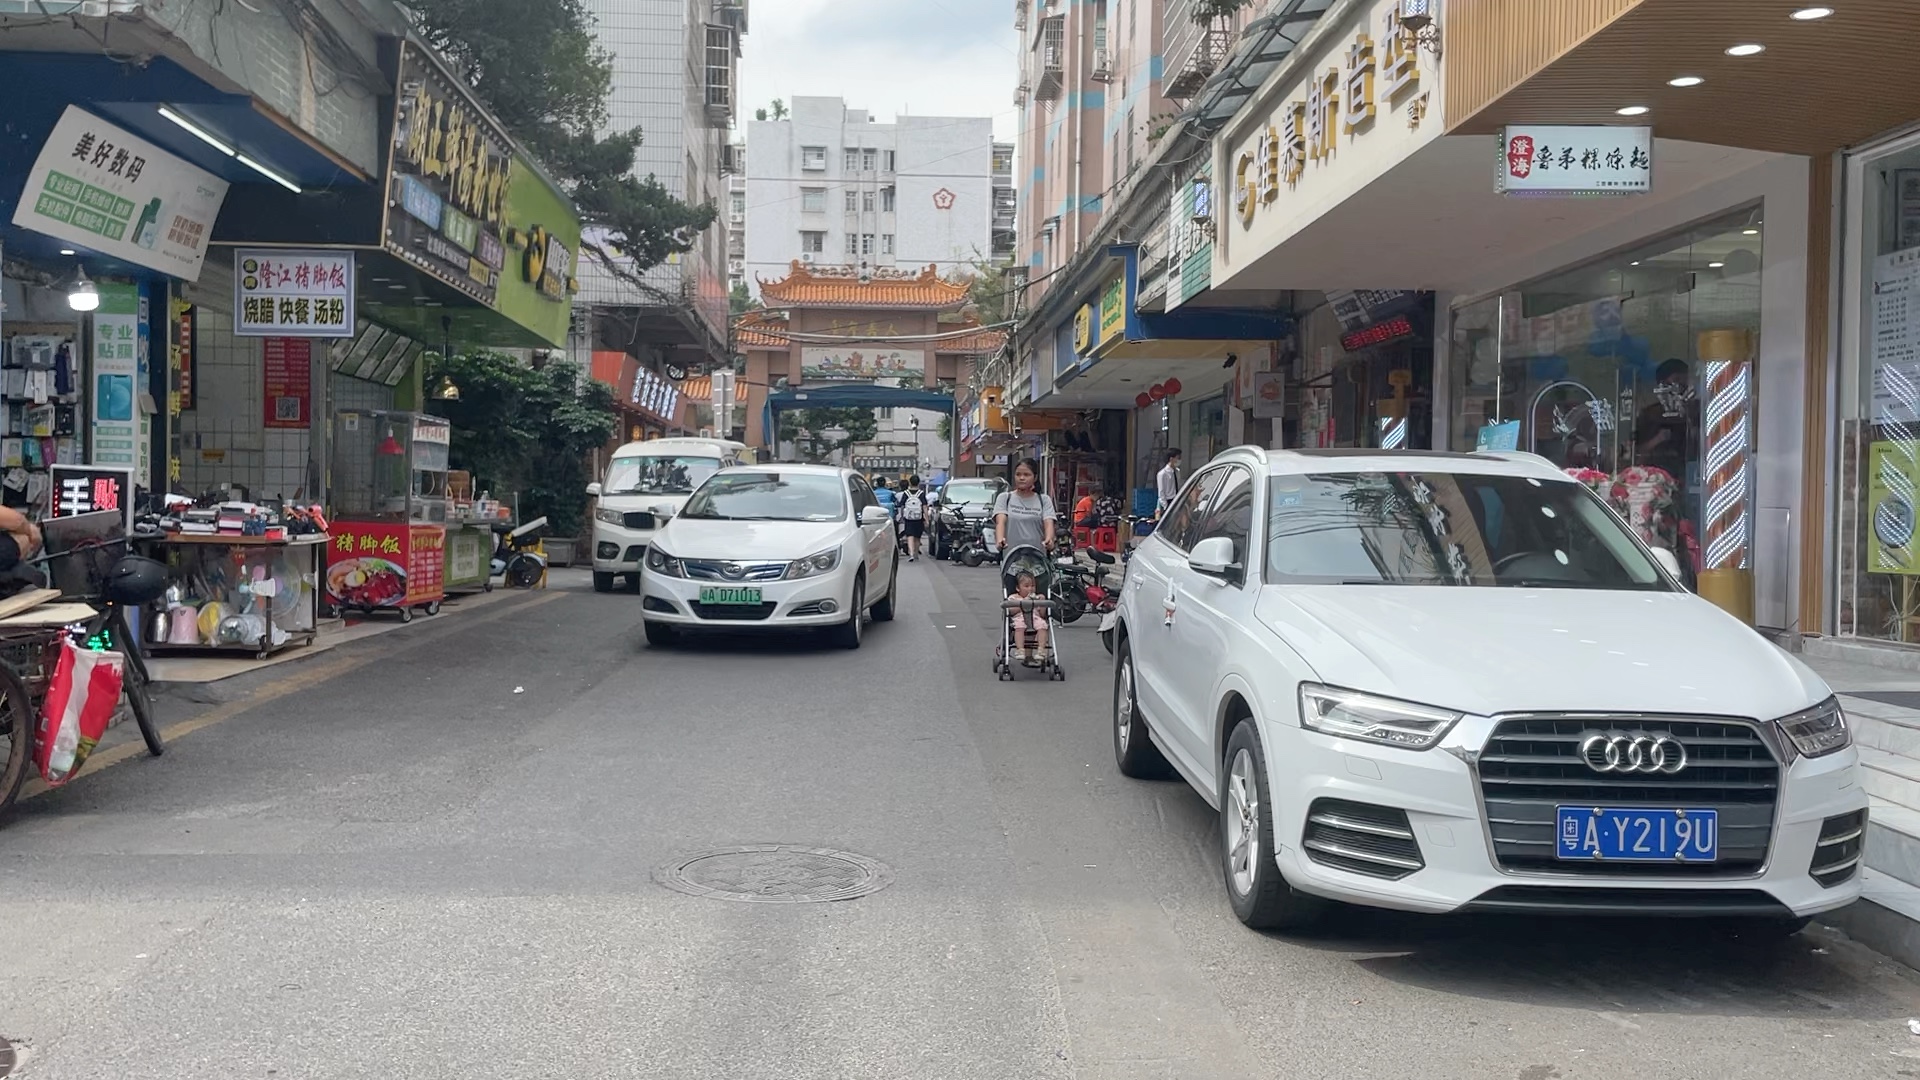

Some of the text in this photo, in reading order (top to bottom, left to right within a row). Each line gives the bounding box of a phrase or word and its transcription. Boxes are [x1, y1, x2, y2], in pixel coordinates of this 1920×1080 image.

[72, 132, 146, 183] 美好数码
[1512, 139, 1531, 175] 澄海
[260, 259, 345, 290] 隆江猪脚饭
[244, 296, 345, 325] 烧腊 快餐 汤粉
[98, 323, 133, 340] 专业
[98, 343, 133, 359] 贴膜
[337, 532, 402, 555] 猪脚饭
